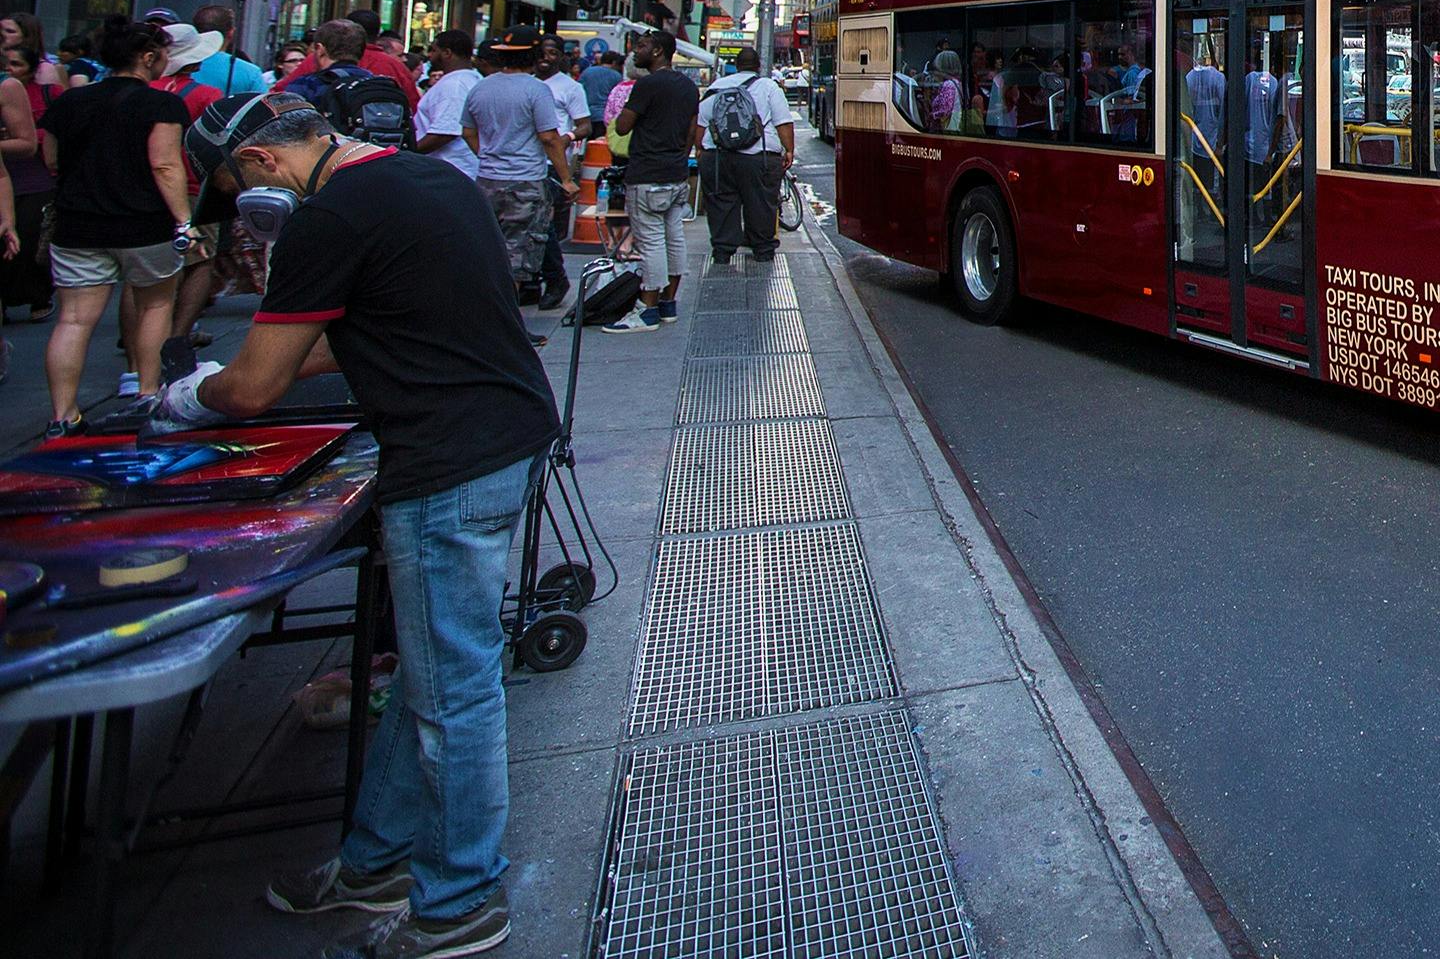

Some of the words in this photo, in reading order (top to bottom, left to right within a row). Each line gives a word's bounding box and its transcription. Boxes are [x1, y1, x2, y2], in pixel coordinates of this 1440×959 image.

[891, 143, 942, 161] BIGBUSTOURS.COM
[1324, 264, 1357, 288] TAXI
[1359, 271, 1420, 302] TOURS,
[1325, 287, 1408, 320] OPERATED
[1412, 304, 1434, 326] BY
[1326, 306, 1352, 328] BIG
[1356, 313, 1387, 336] BUS
[1327, 325, 1361, 350] NEW
[1364, 333, 1409, 362] YORK
[1328, 344, 1380, 373] USDOT
[1329, 363, 1358, 387] NYS
[1361, 371, 1394, 396] DOT
